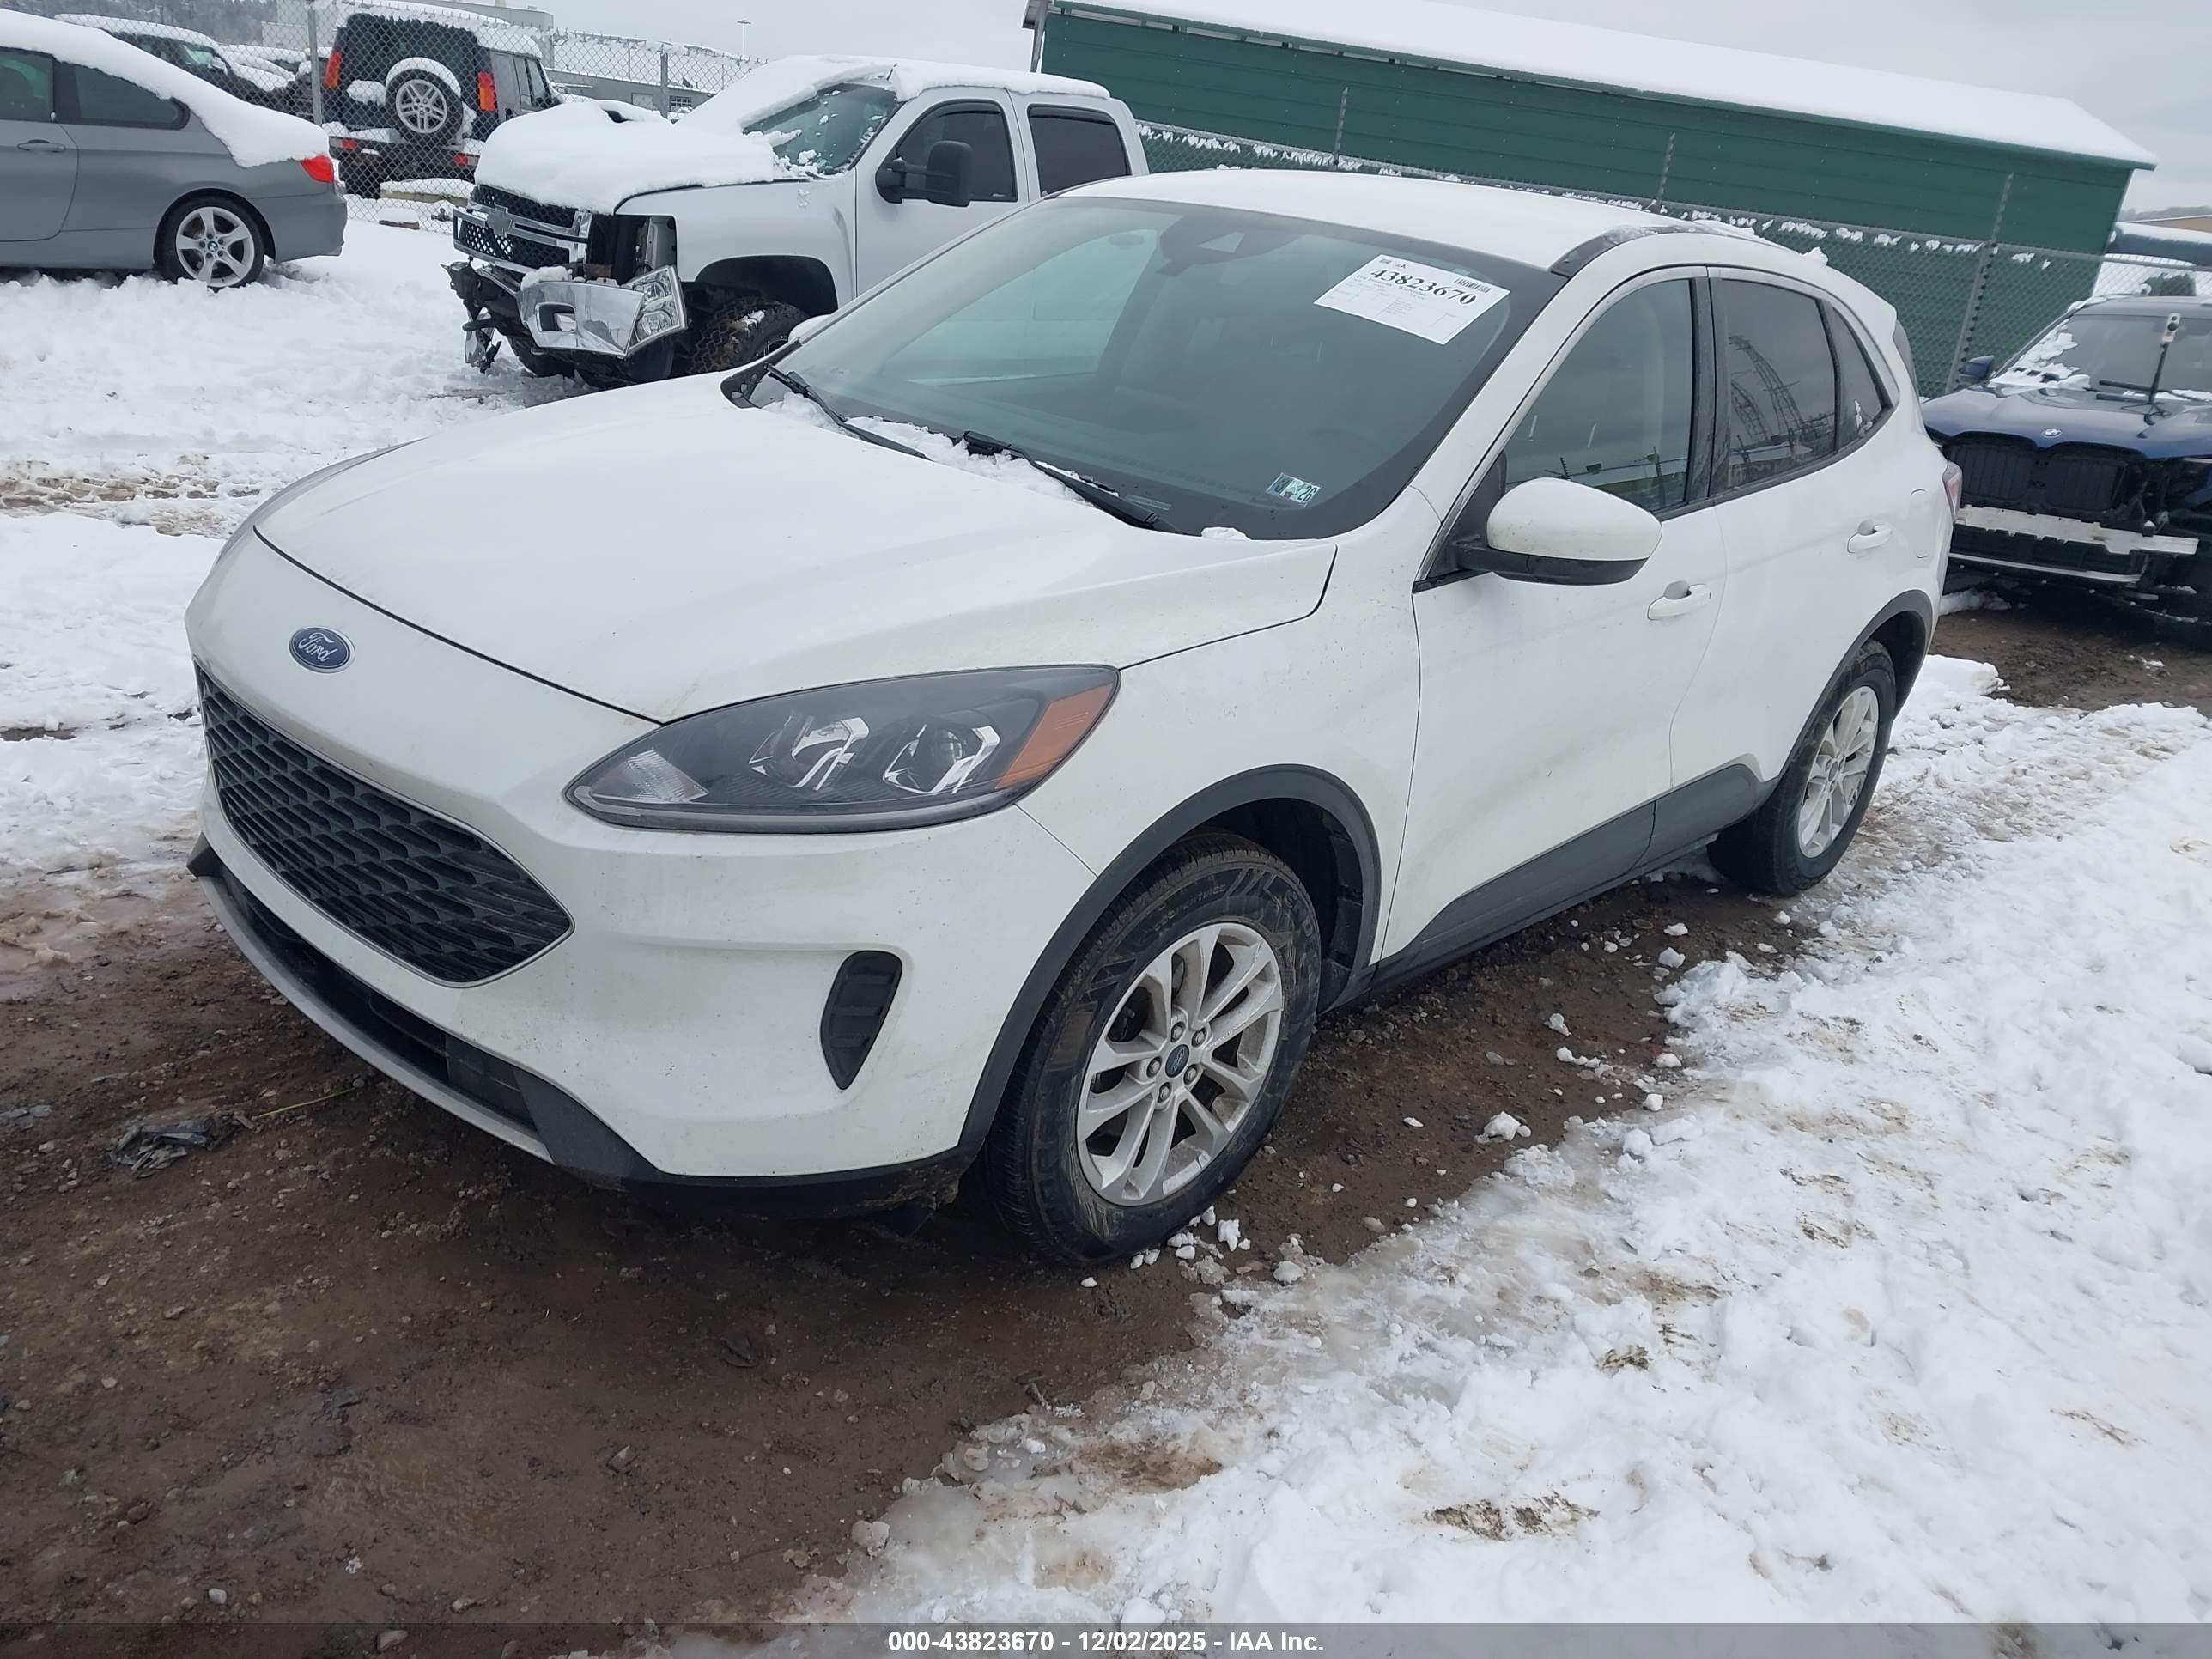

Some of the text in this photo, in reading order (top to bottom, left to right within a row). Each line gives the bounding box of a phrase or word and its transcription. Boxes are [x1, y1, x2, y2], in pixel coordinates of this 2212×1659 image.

[1371, 269, 1477, 305] 43823670
[1297, 485, 1317, 502] 26
[298, 633, 337, 661] Ford
